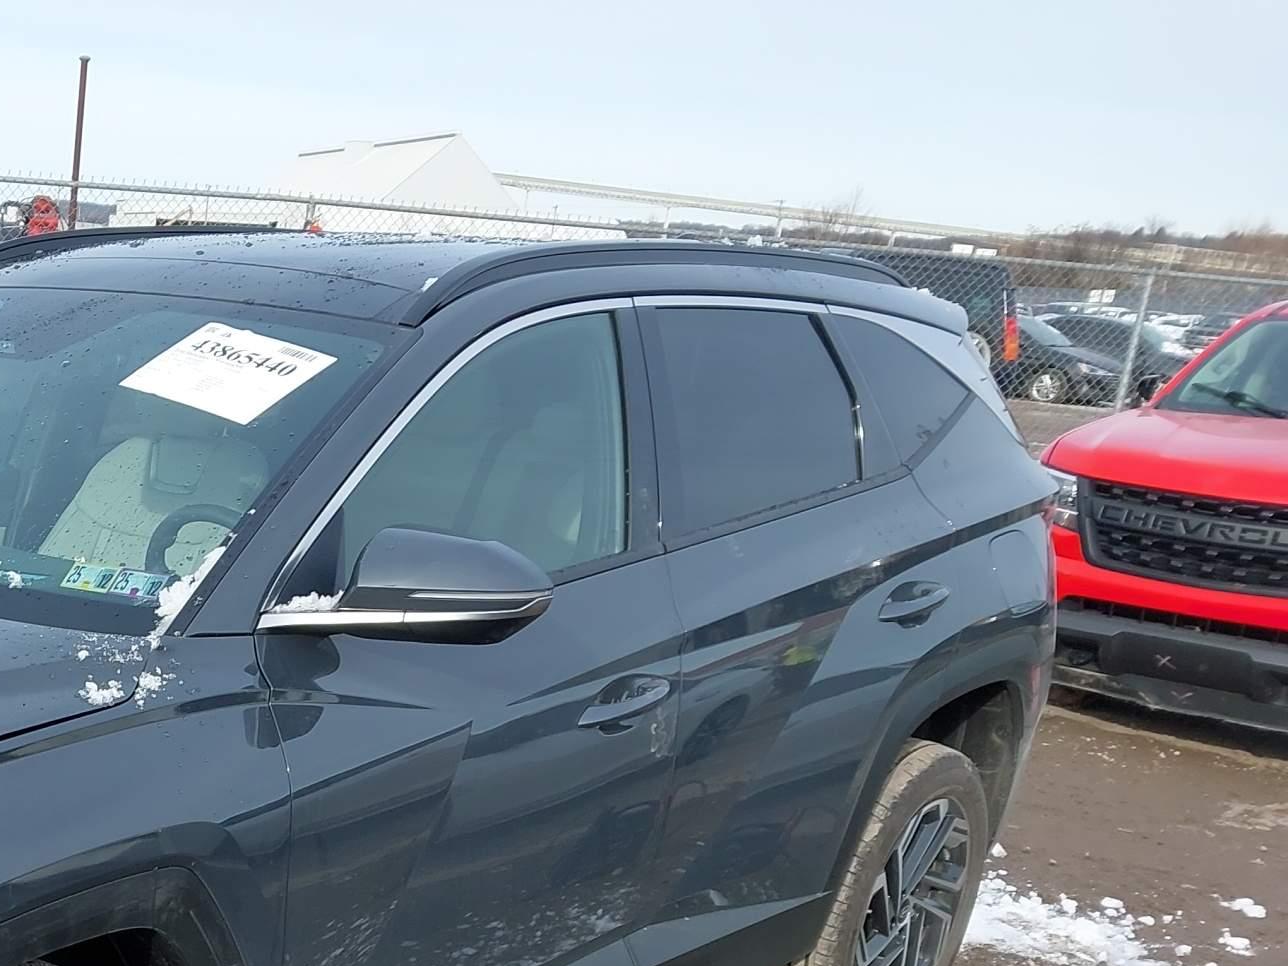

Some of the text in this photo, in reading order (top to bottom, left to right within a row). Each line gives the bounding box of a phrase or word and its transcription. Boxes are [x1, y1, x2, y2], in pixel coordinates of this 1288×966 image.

[192, 339, 298, 377] 43865440
[66, 565, 114, 590] 25 12
[113, 572, 163, 597] 25 12
